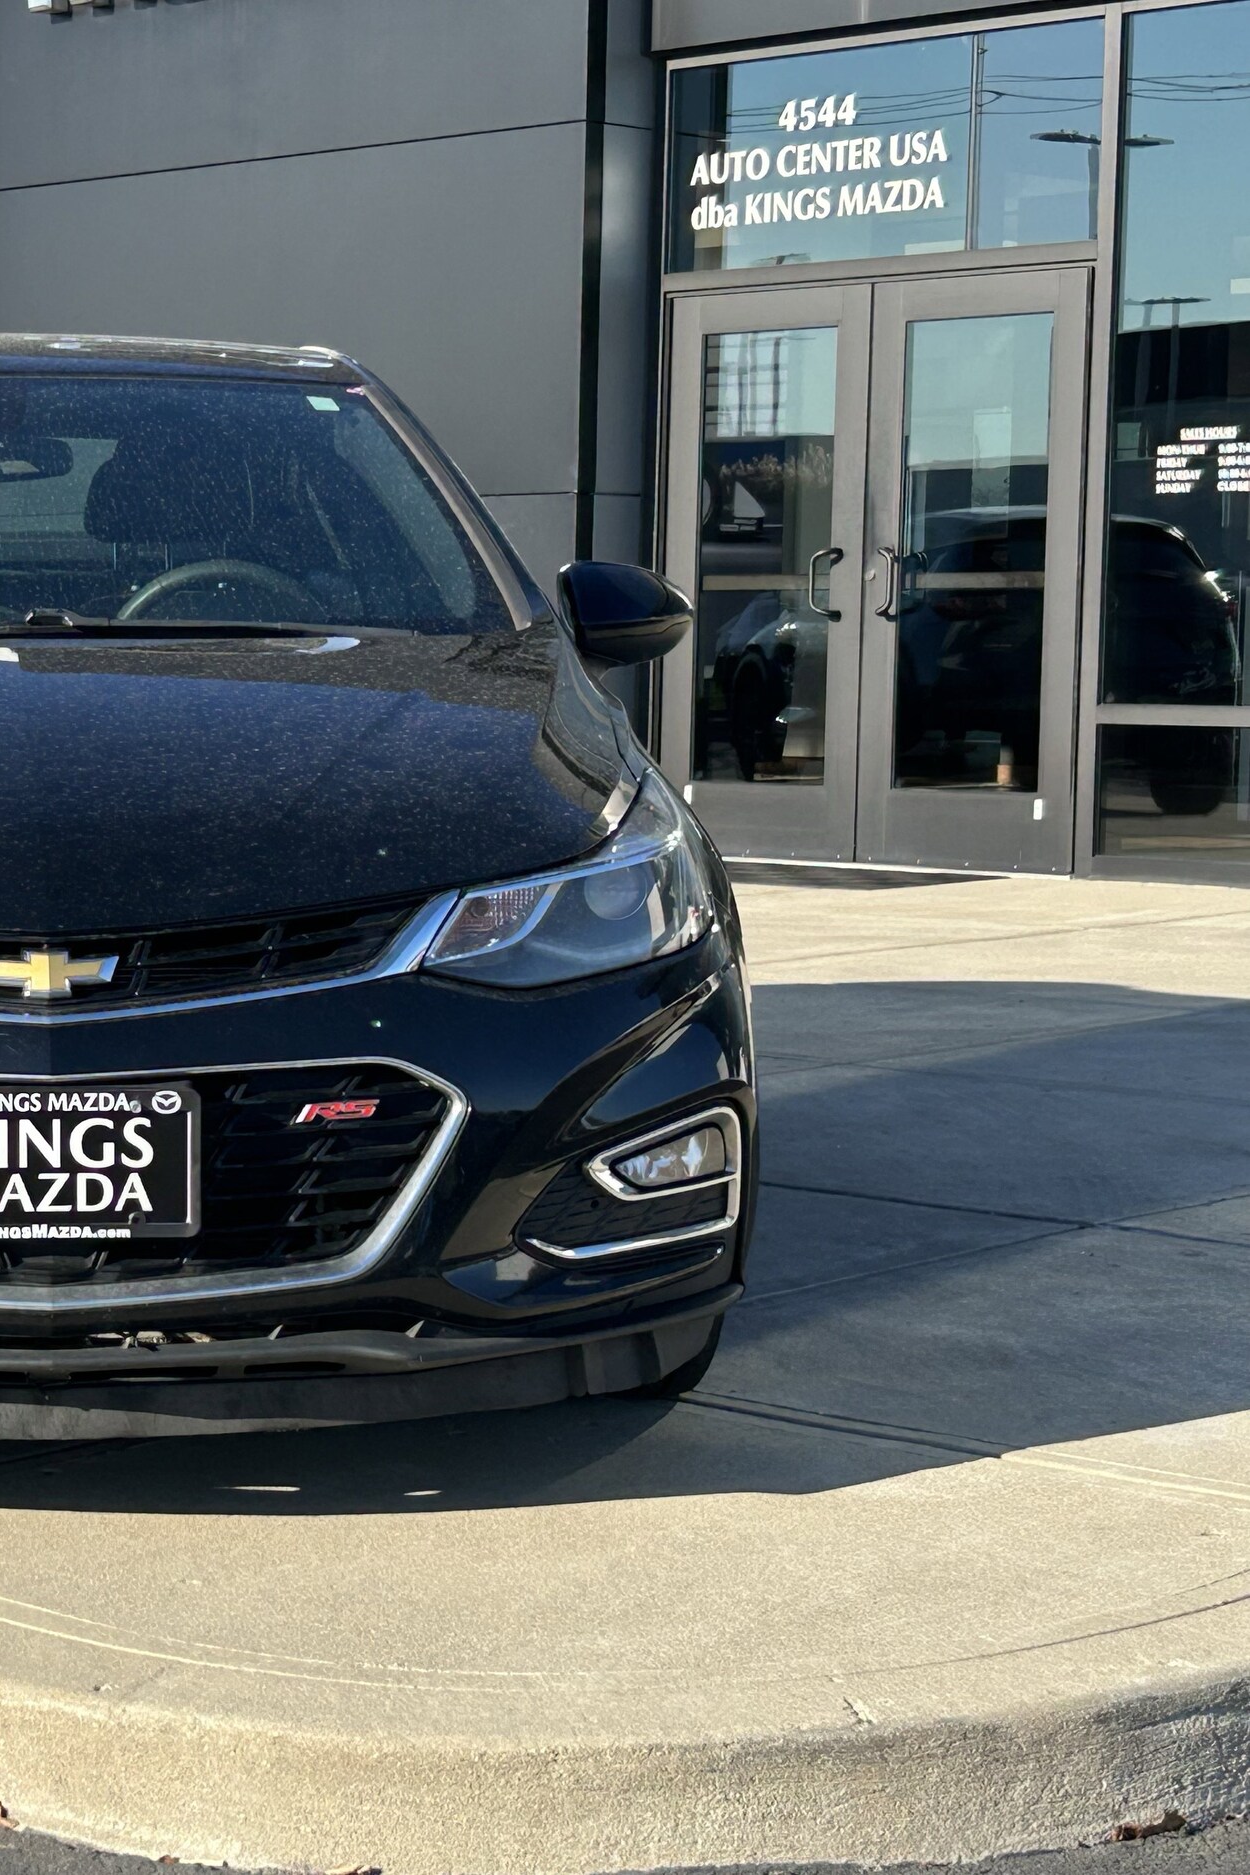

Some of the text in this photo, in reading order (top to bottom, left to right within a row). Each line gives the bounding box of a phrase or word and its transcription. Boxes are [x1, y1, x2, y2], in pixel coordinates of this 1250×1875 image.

[778, 92, 856, 132] 4544
[690, 129, 948, 186] AUTO CENTER USA
[691, 176, 944, 230] dba KINGS MAZDA
[47, 1092, 131, 1112] MAZDA
[295, 1099, 380, 1124] RS
